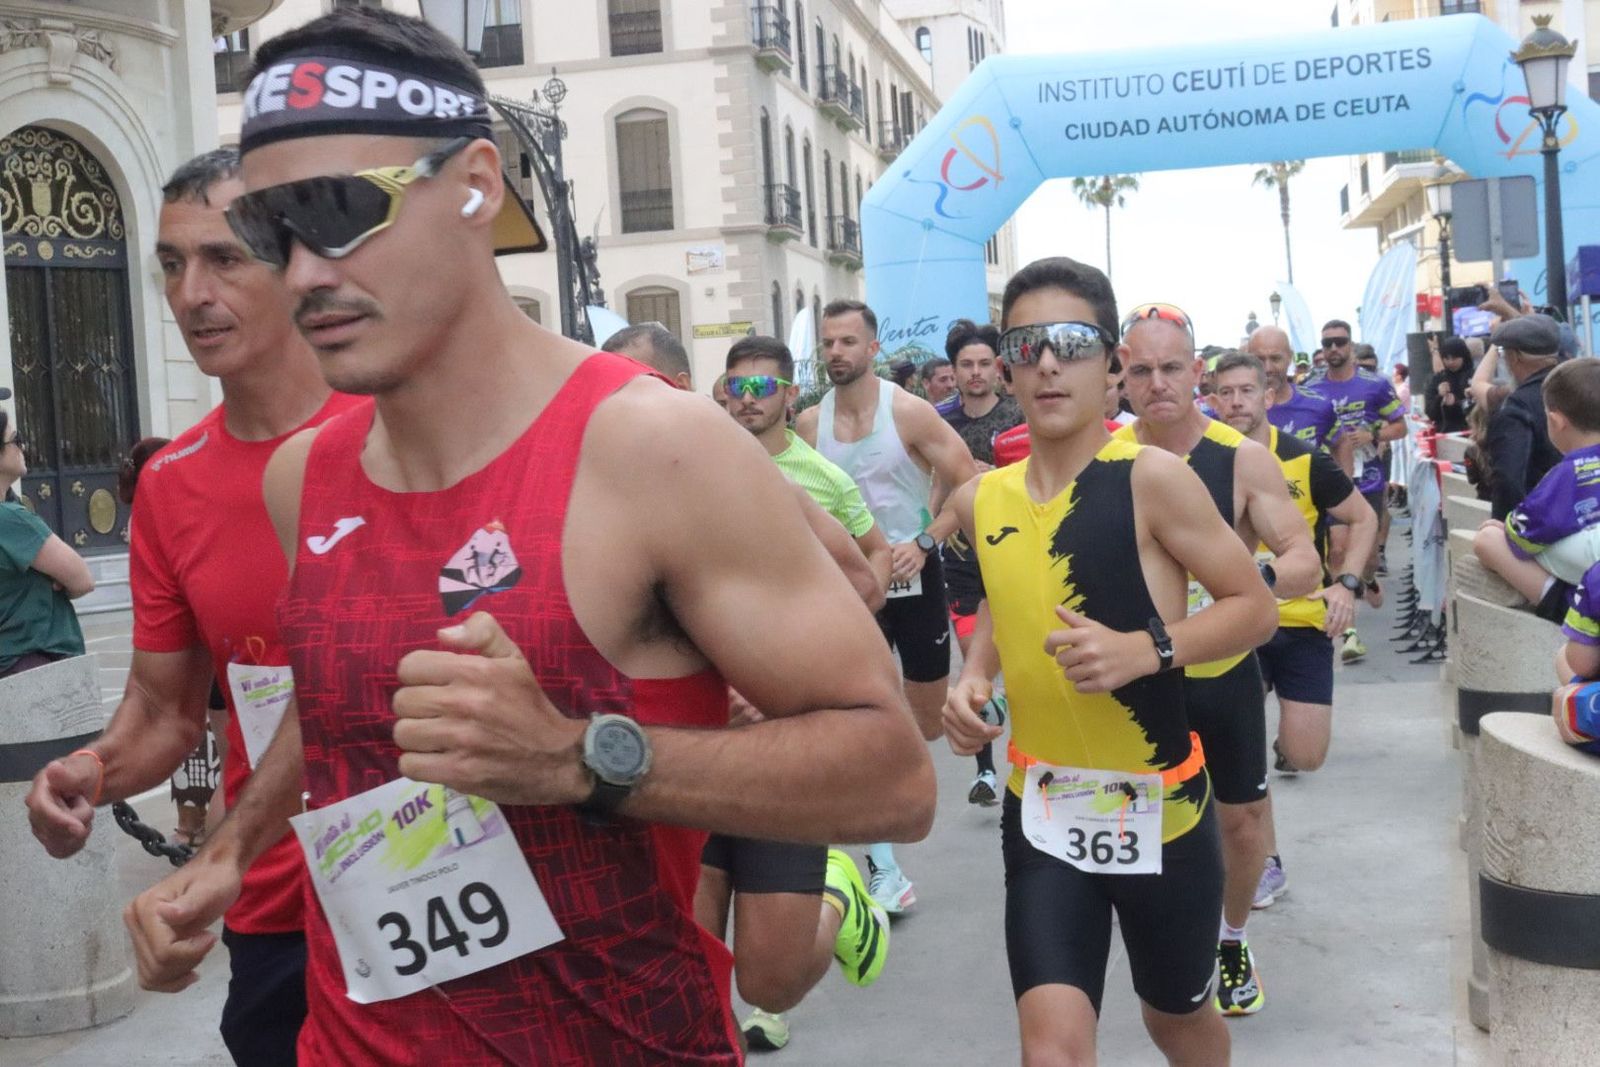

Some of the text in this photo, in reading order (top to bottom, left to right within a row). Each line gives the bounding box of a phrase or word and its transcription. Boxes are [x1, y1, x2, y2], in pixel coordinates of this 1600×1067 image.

[1038, 47, 1432, 103] INSTITUTO CEUTÍ DE DEPORTES
[1065, 94, 1411, 141] CIUDAD AUTÓNOMA DE CEUTA
[391, 788, 434, 830] 10K
[1066, 827, 1141, 865] 363
[376, 881, 510, 976] 349
